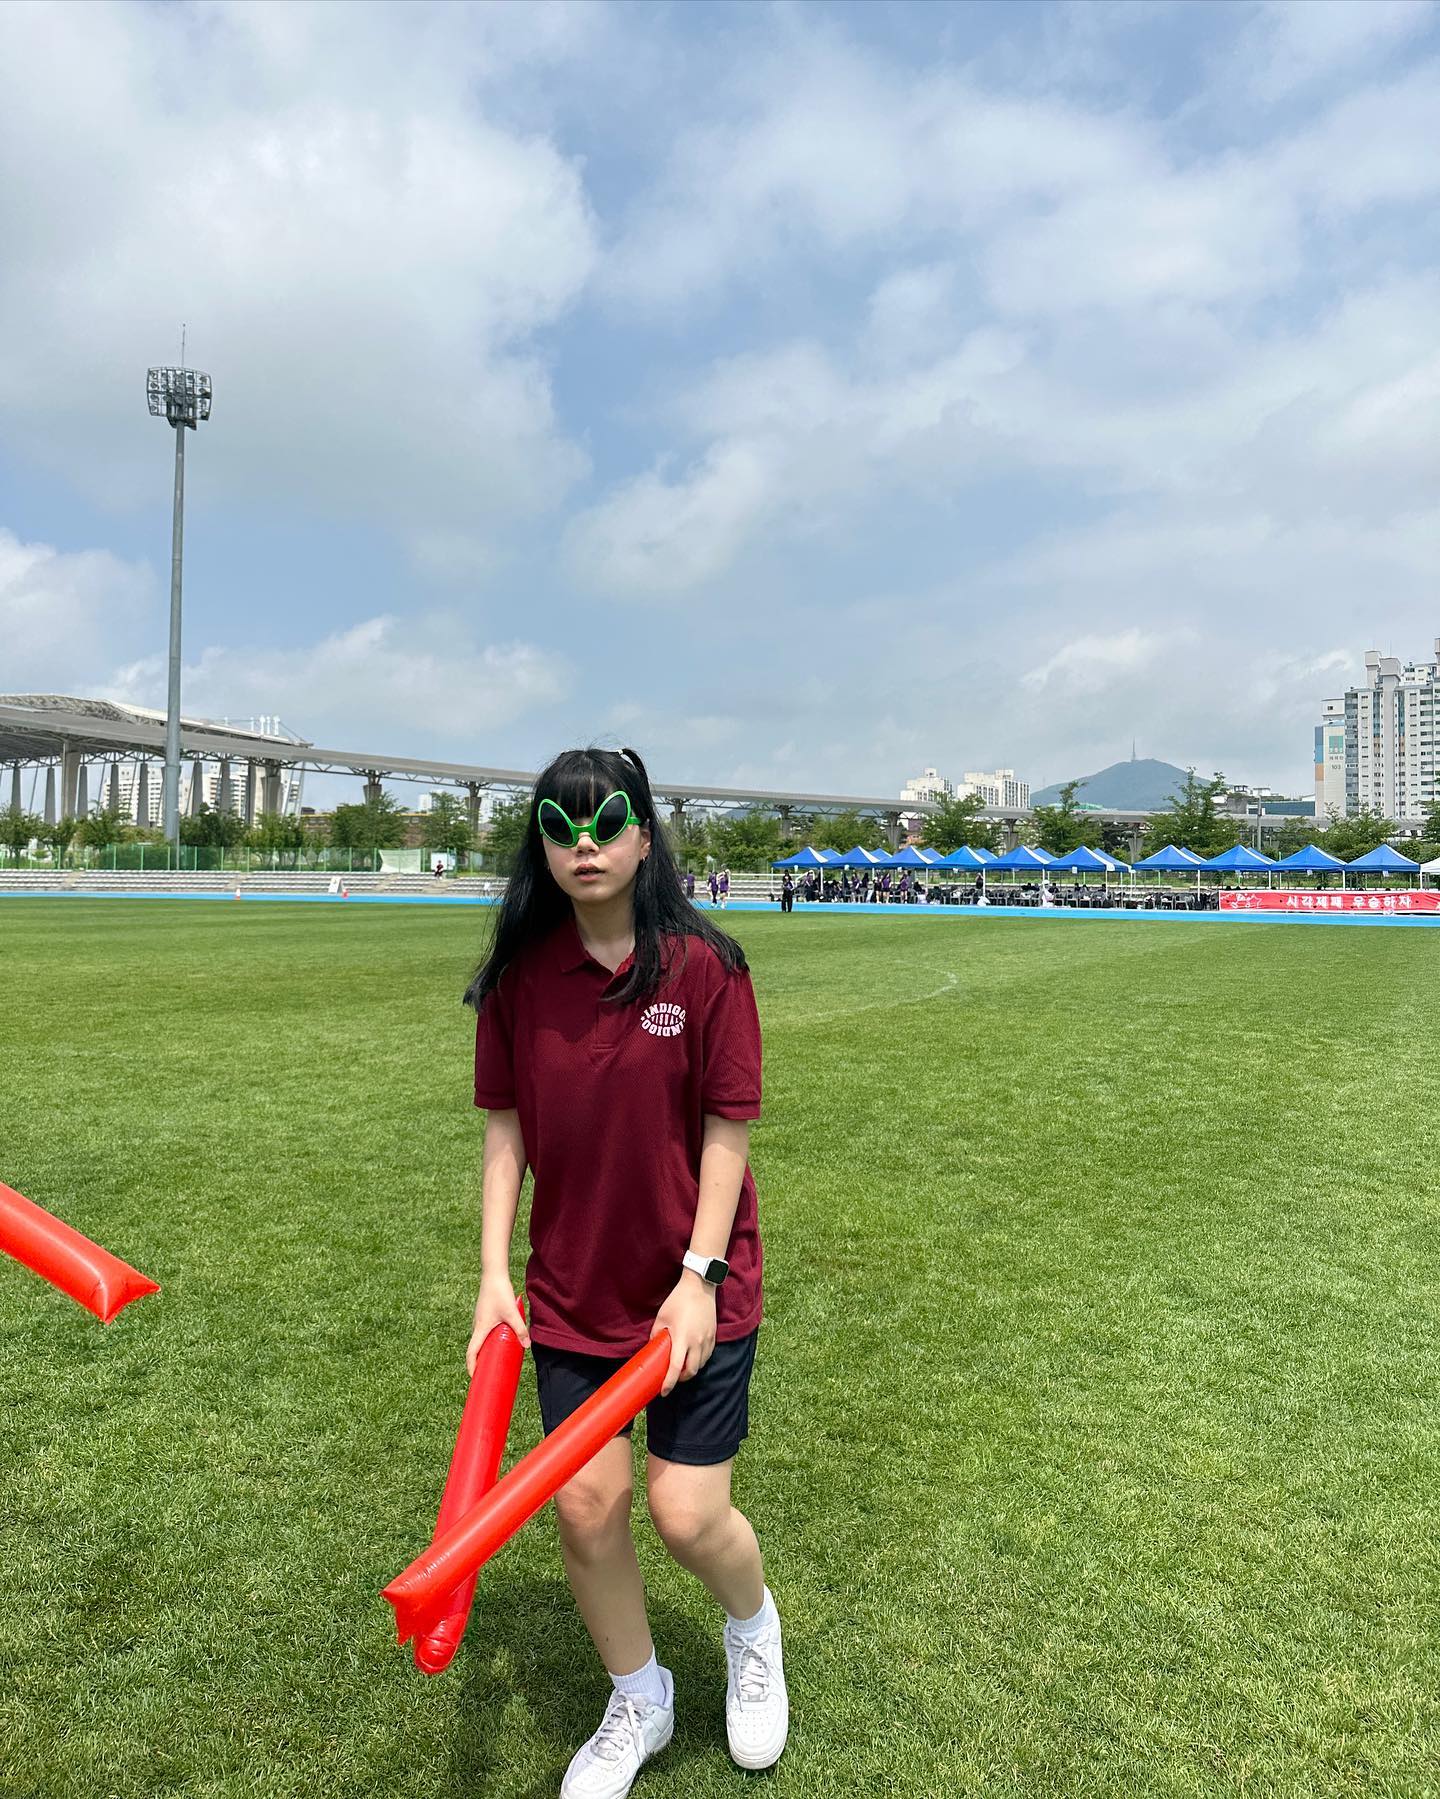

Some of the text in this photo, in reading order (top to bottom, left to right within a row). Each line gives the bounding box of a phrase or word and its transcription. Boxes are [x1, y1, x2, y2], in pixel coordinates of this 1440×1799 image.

[1353, 895, 1411, 908] 우승하자
[643, 1003, 686, 1020] INDIGO
[651, 1013, 679, 1025] VISUAL
[641, 1019, 684, 1037] INDIGO
